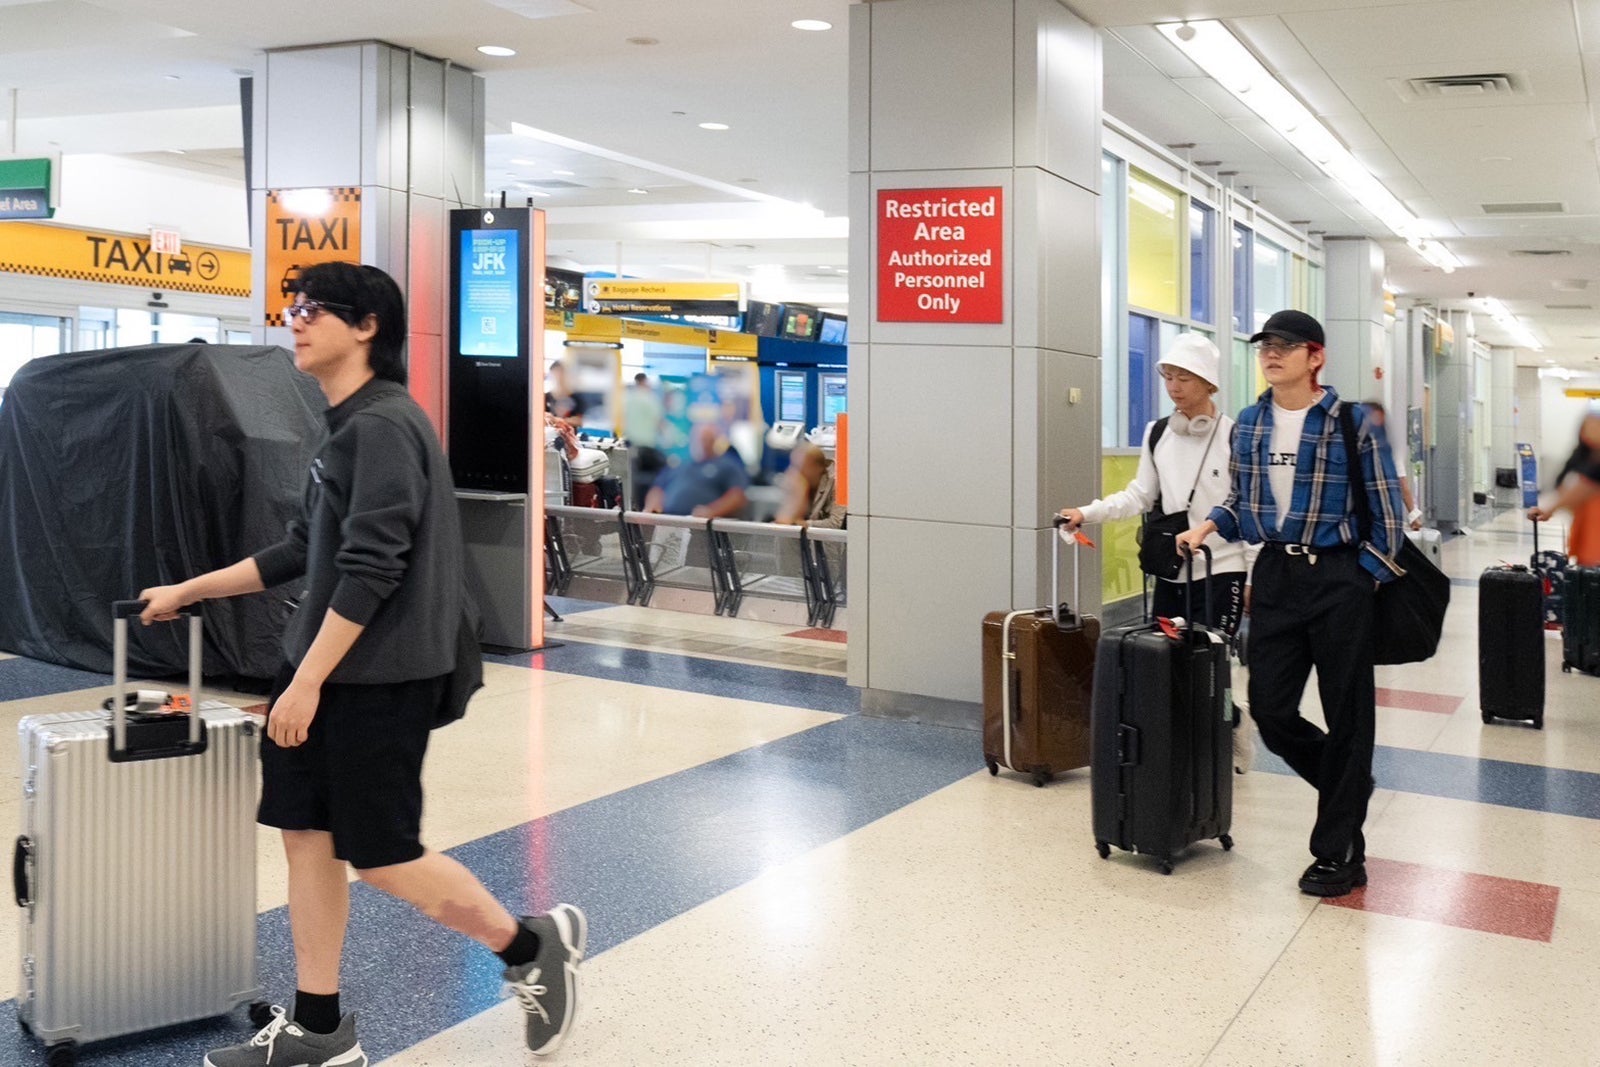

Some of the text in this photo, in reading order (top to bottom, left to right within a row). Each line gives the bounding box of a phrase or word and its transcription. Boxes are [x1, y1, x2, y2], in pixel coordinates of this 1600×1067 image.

[13, 197, 38, 210] Area
[886, 196, 995, 218] Restricted
[276, 218, 348, 250] TAXI
[914, 222, 965, 241] Area
[155, 231, 177, 253] EXIT
[86, 236, 163, 275] TAXI
[472, 253, 506, 270] JFK
[888, 249, 991, 267] Authorized
[895, 271, 985, 288] Personnel
[612, 286, 639, 295] Baggage
[612, 304, 672, 312] Hotel Reservations
[917, 293, 960, 314] Only
[1230, 580, 1241, 621] TOMMY
